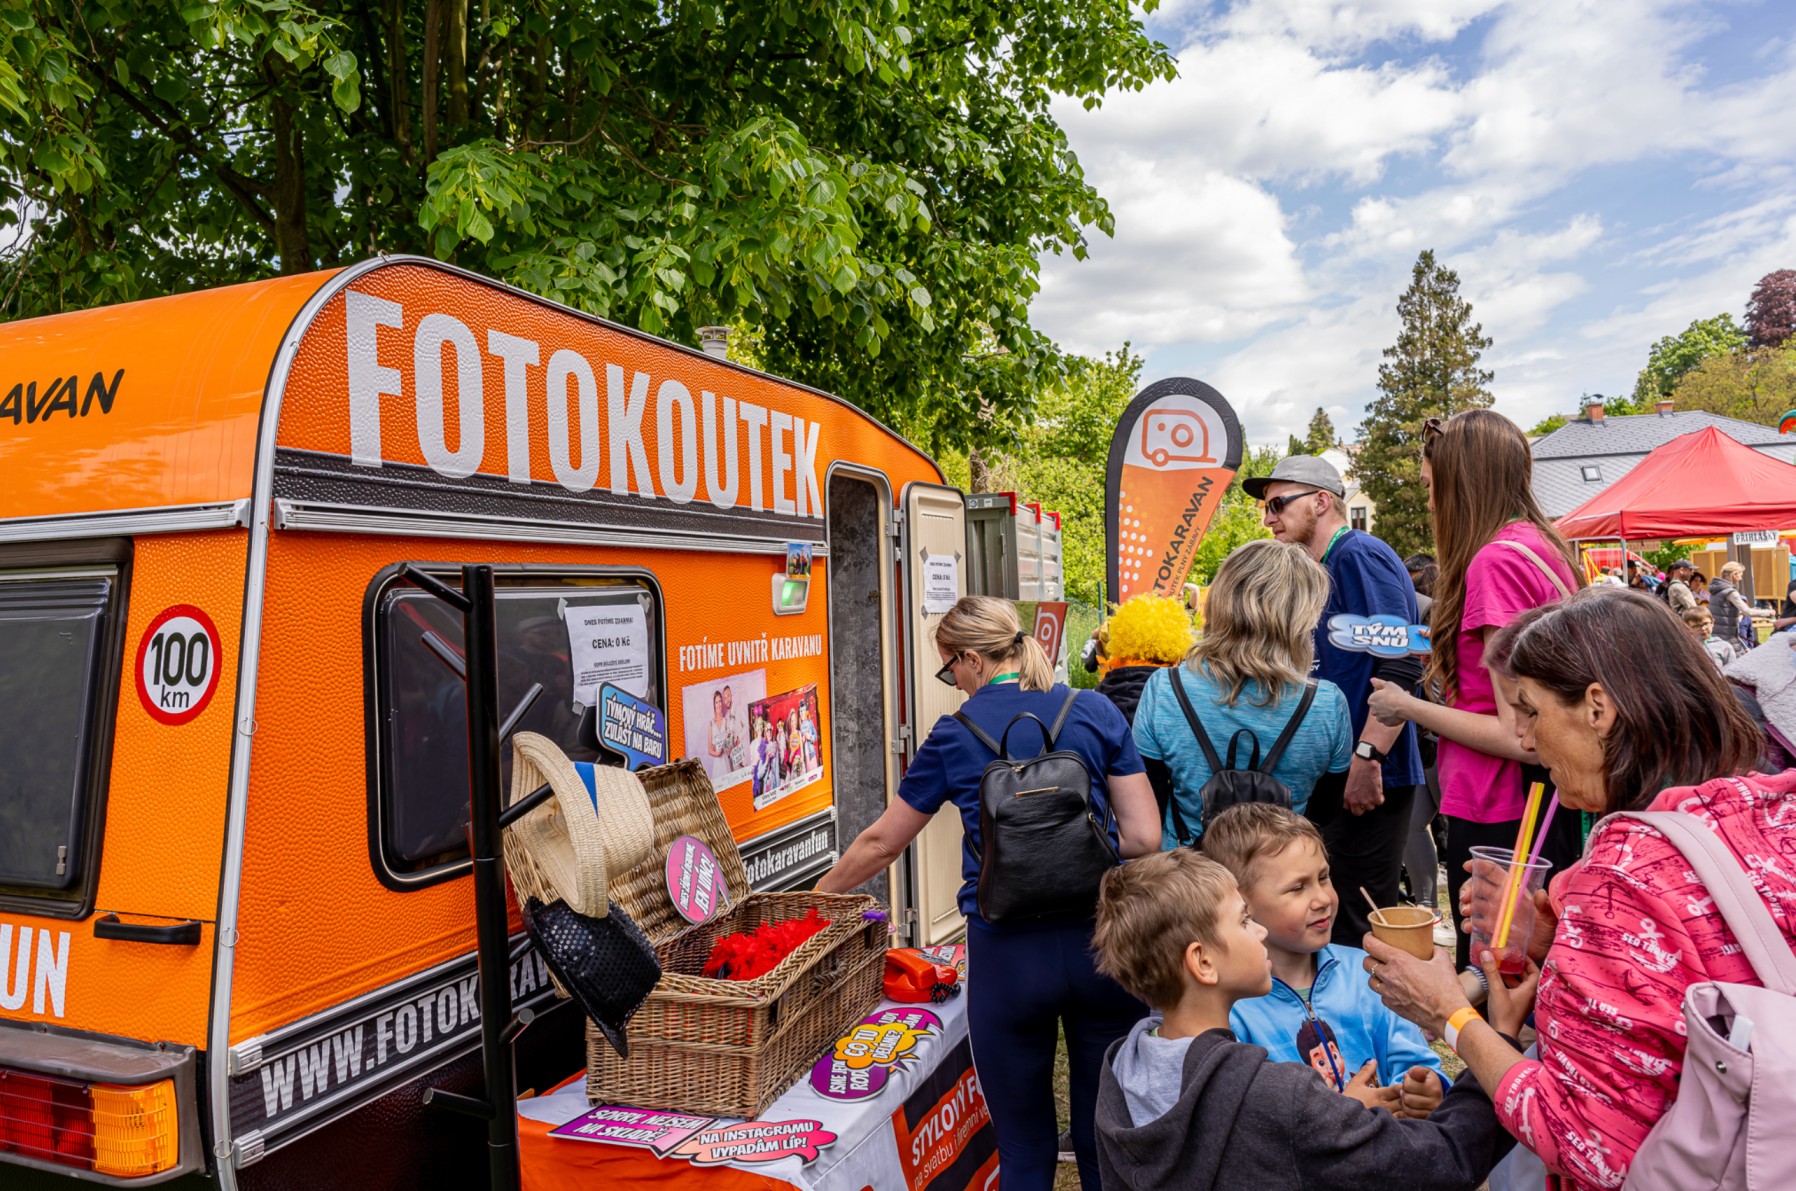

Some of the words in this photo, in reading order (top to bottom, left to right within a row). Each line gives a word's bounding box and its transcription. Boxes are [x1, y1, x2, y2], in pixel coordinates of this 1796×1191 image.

[345, 290, 824, 519] FOTOKOUTEK
[1152, 476, 1214, 597] TOKARAVAN
[1351, 621, 1407, 636] TÝM
[592, 637, 615, 649] CENA:
[615, 637, 621, 647] 0
[621, 635, 631, 647] Kč
[680, 636, 725, 672] FOTÍME
[727, 631, 769, 666] UVNITŘ
[771, 633, 822, 661] KARAVANU
[1352, 634, 1409, 648] SNŮ
[150, 632, 209, 687] 100
[160, 684, 190, 708] km
[606, 694, 637, 727] TÝMOVÝ
[632, 730, 643, 751] NA
[643, 736, 662, 759] BARU
[694, 852, 715, 893] VÍNO!
[694, 884, 710, 916] JEN
[852, 1029, 879, 1041] TU
[868, 1029, 905, 1059] DĚLÁME?
[844, 1042, 869, 1057] CO
[828, 1074, 848, 1094] JSME
[849, 1069, 870, 1091] ROD
[1508, 1067, 1536, 1096] TRAVEL
[573, 1121, 597, 1134] NA
[588, 1108, 641, 1125] SORRY,
[645, 1113, 701, 1130] NEJSEM
[912, 1079, 966, 1166] STYLOVÝ
[700, 1132, 721, 1145] NA
[723, 1121, 815, 1143] INSTAGRAMU
[924, 1142, 954, 1179] svatbu
[979, 1104, 989, 1120] ve
[1565, 1131, 1586, 1152] SEA
[711, 1135, 780, 1159] VYPADÁM
[783, 1137, 808, 1150] LÍP!
